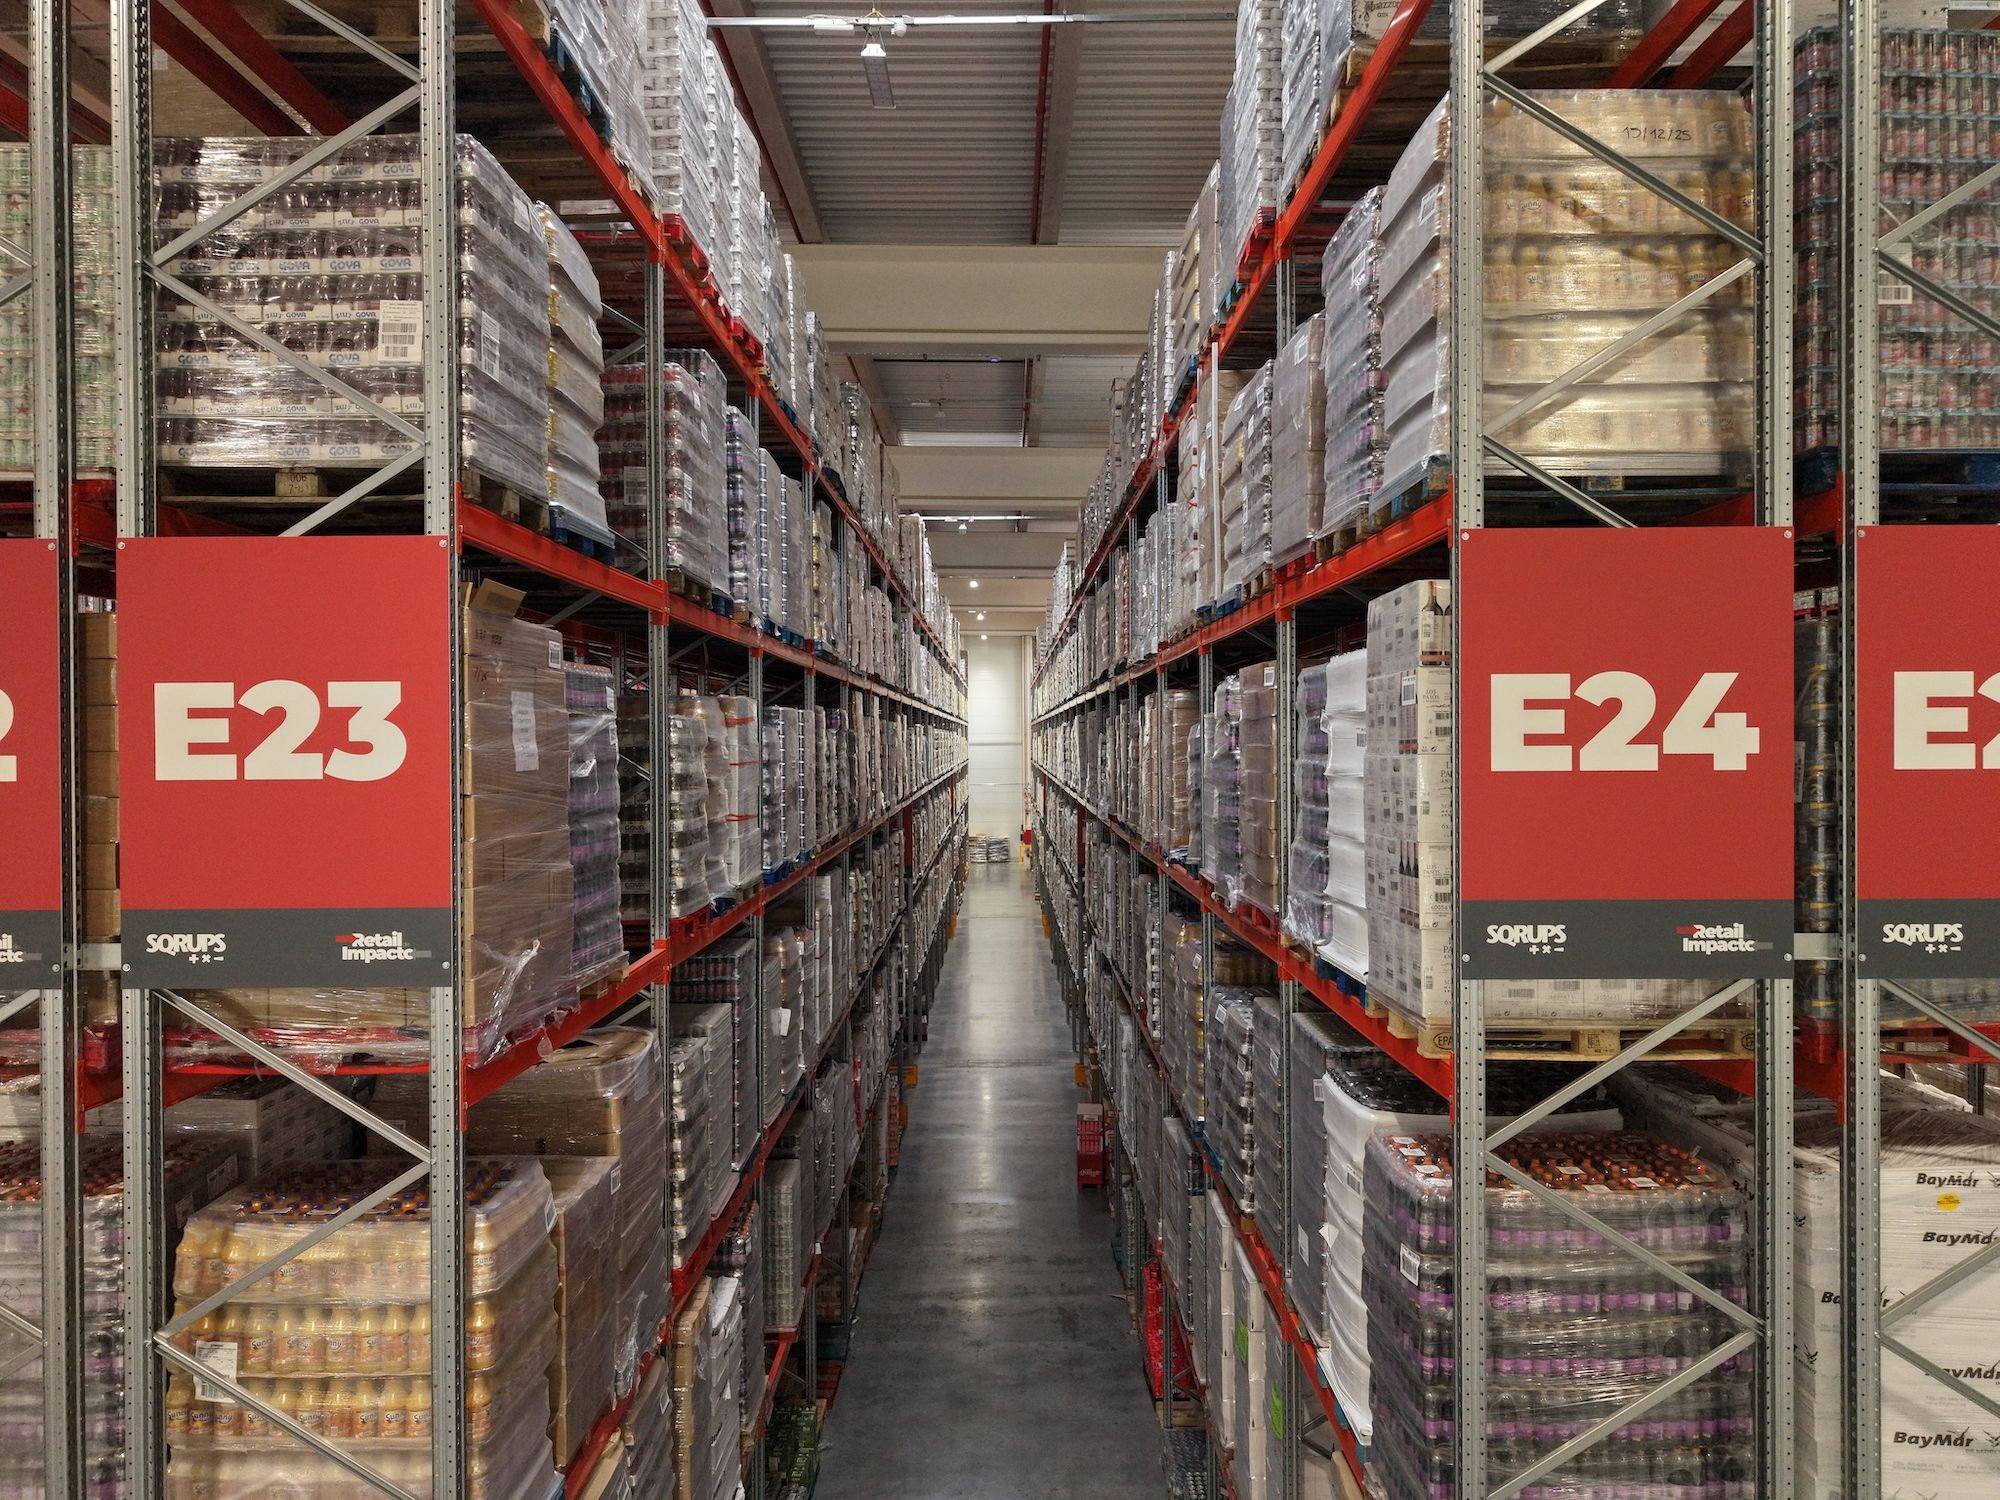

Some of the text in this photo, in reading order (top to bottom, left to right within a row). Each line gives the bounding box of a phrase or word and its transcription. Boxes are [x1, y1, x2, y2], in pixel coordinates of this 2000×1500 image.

[331, 166, 363, 178] GOYA
[382, 164, 414, 174] GOYA
[329, 260, 361, 271] GOYA
[380, 257, 412, 269] GOYA
[178, 354, 209, 365] GOYA
[329, 352, 360, 364] GOYA
[329, 446, 361, 457] GOYA
[1491, 671, 1760, 771] E24
[154, 679, 407, 782] E23
[1486, 924, 1568, 947] SQRUPS
[1692, 922, 1744, 940] Retail
[1882, 923, 1964, 946] SQRUPS
[352, 930, 402, 947] Retail
[146, 933, 227, 957] SQRUPS
[474, 1256, 497, 1266] Sunny
